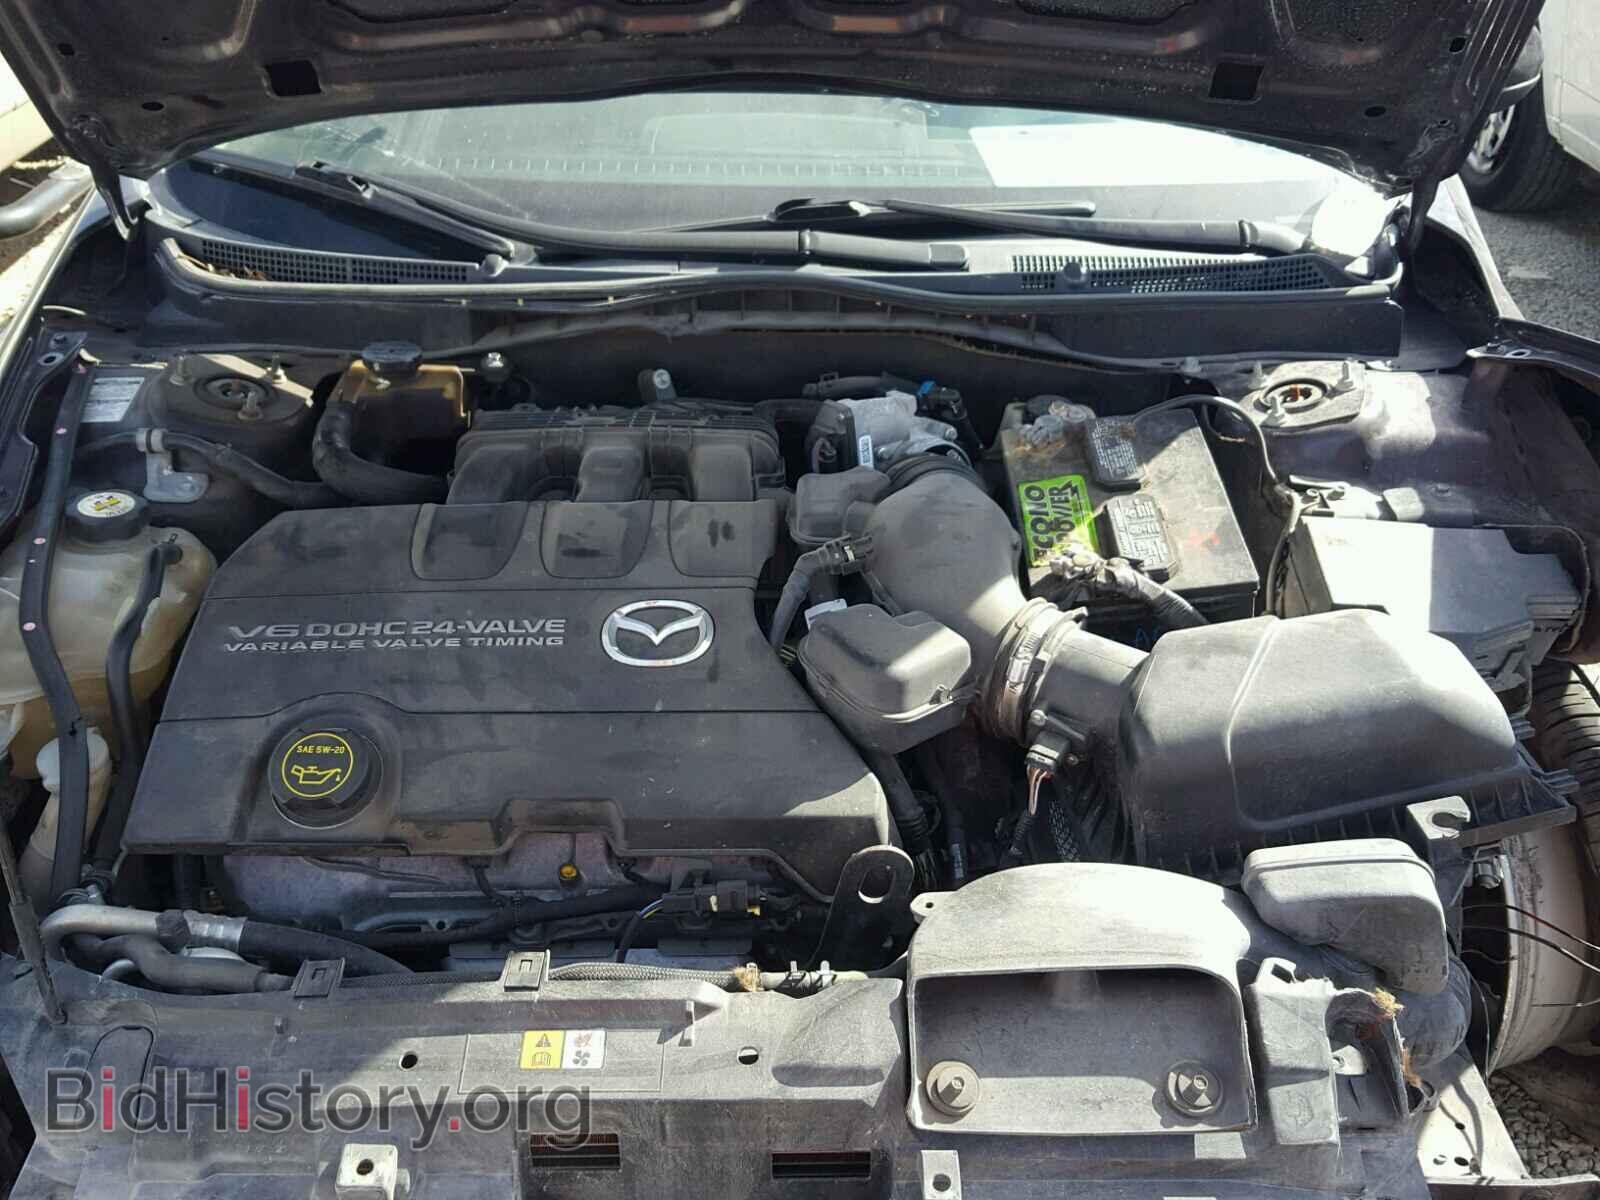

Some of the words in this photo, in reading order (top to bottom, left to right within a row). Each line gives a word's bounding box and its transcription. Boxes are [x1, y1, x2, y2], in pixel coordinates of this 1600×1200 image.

[228, 623, 299, 639] V6
[304, 621, 407, 637] DOHC
[411, 618, 567, 635] 24-VALVE
[223, 639, 366, 652] VARIABLE
[372, 637, 462, 649] VALVE
[469, 636, 565, 648] TIMING
[296, 745, 315, 754] SAE
[315, 745, 346, 754] 5W-20
